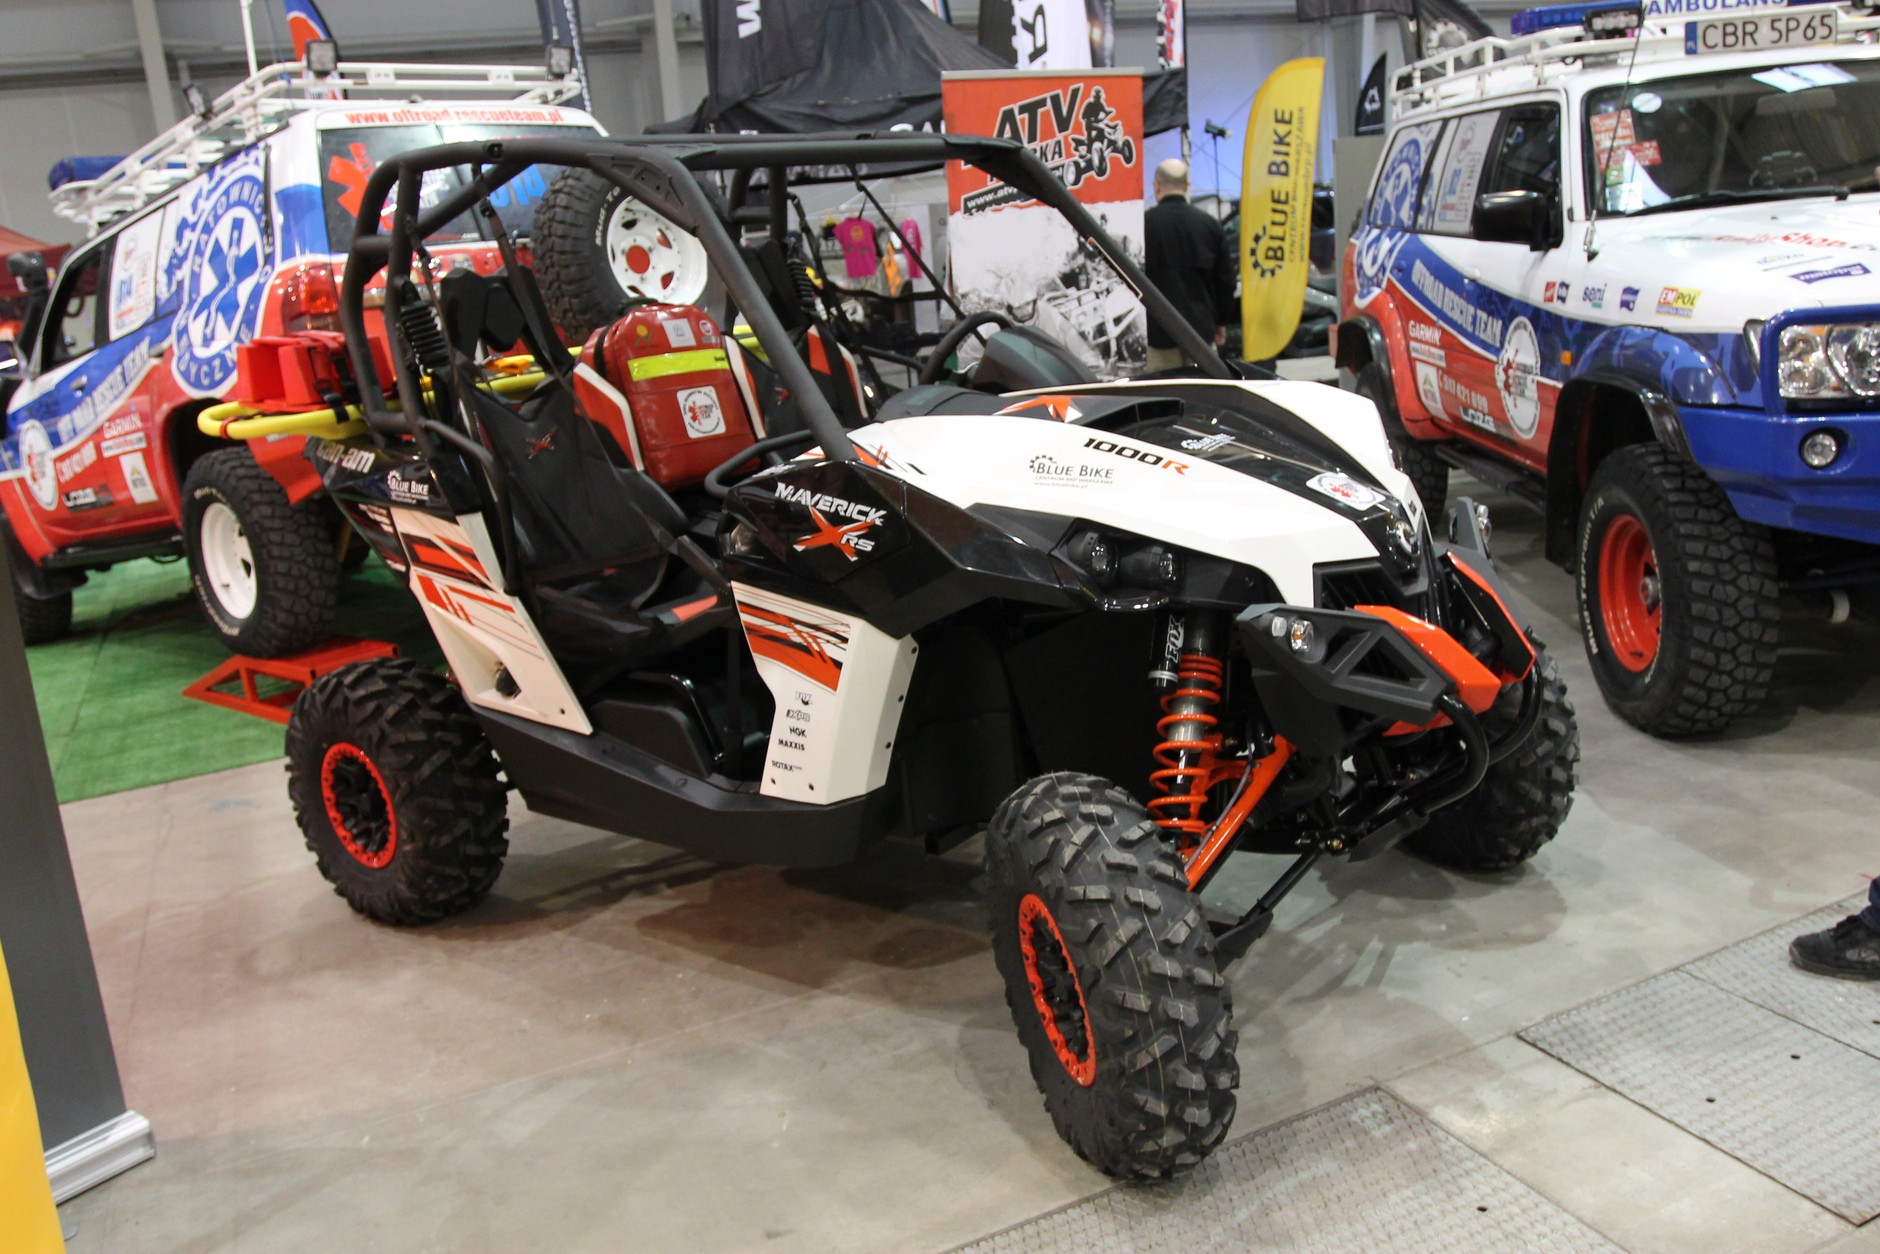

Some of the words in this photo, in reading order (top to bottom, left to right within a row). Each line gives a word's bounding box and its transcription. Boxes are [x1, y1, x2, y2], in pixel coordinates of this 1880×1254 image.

[1648, 0, 1784, 15] AMBULA
[1702, 20, 1759, 49] CBR
[1770, 14, 1833, 44] 5P65
[996, 85, 1083, 147] ATV
[1268, 109, 1294, 177] BIKE
[1264, 189, 1289, 263] BLUE
[1408, 320, 1441, 345] GARMIN
[316, 441, 376, 473] can-am
[1036, 462, 1074, 476] BLUE
[1079, 465, 1114, 479] BIKE
[1083, 437, 1190, 476] 1000R
[390, 480, 409, 492] BLUE
[410, 480, 429, 495] BIKE
[774, 482, 887, 526] MAVERICK
[1165, 615, 1185, 663] FOX
[778, 738, 805, 751] MAXXIS
[771, 760, 794, 772] ROTAX
